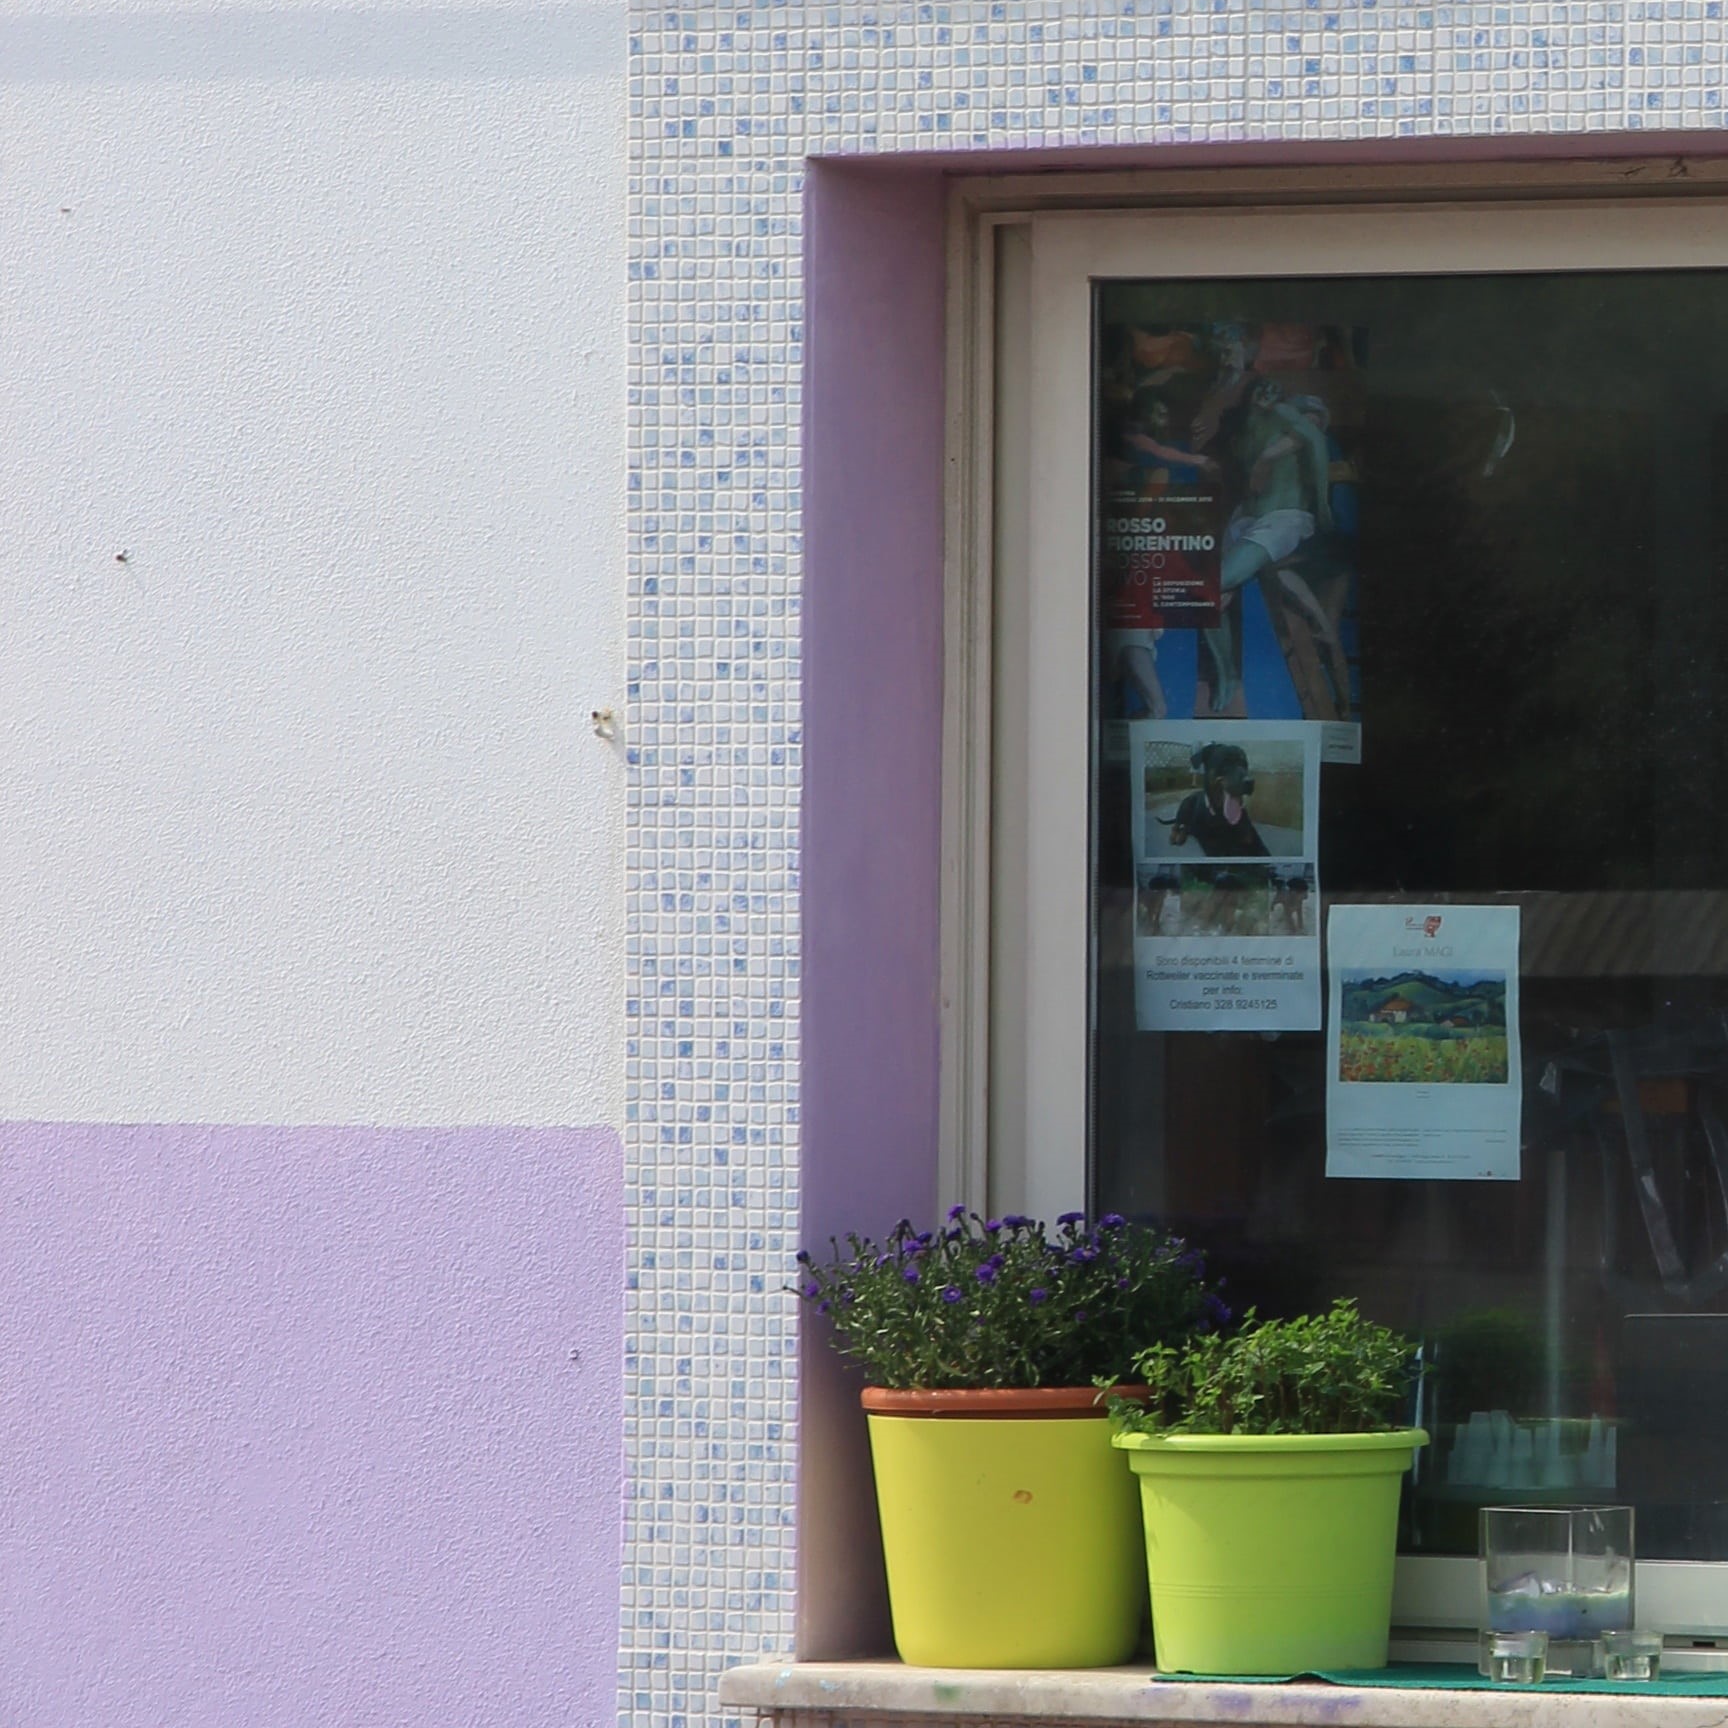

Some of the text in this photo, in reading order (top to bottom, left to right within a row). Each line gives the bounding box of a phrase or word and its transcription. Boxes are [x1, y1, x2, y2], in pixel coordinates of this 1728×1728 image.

[1107, 517, 1167, 534] ROSSO
[1107, 535, 1215, 551] FIORENTINO
[1118, 552, 1166, 569] OSSO
[1155, 954, 1294, 969] Sono disponibili 4 femmine di
[1146, 969, 1191, 980] Rottweiler
[1193, 969, 1240, 980] vaccinate
[1251, 969, 1304, 980] sverminate
[1202, 986, 1220, 996] per
[1169, 999, 1212, 1010] Cristiano
[1214, 999, 1233, 1010] 328
